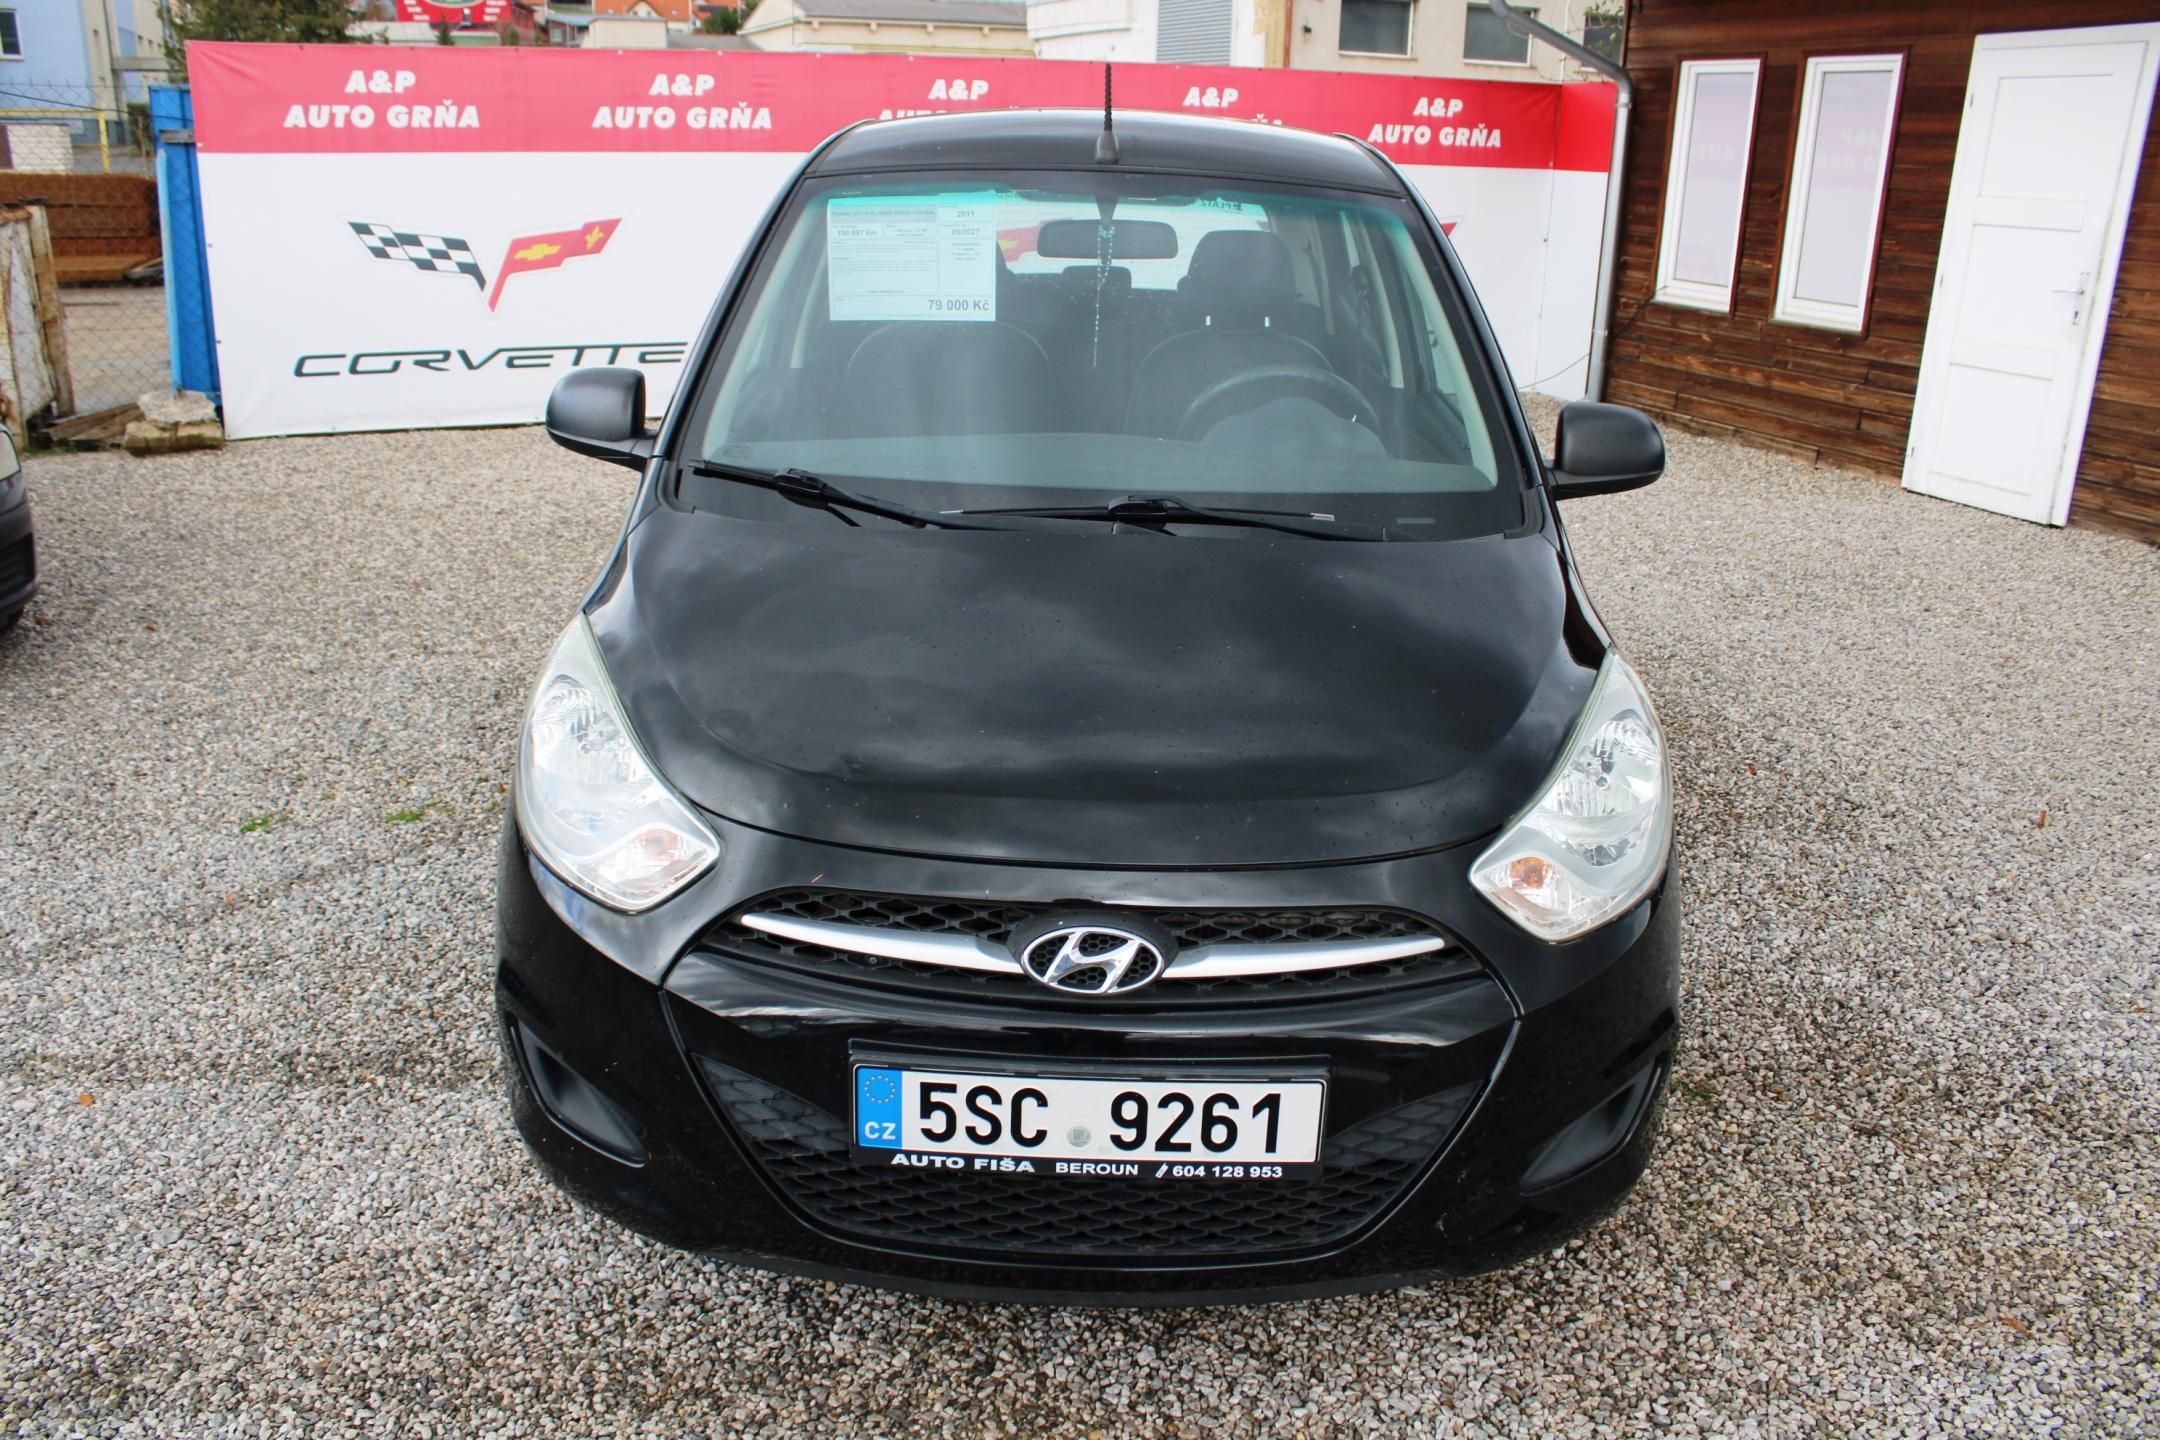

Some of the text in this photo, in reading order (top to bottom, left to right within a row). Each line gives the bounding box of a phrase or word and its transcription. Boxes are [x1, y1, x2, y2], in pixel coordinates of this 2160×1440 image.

[344, 69, 416, 94] A&P
[648, 73, 716, 97] A&P
[927, 78, 990, 101] A&P
[1182, 86, 1240, 109] A&P
[1412, 96, 1464, 118] A&P
[282, 98, 481, 129] AUTO GRŇA
[591, 100, 773, 130] AUTO GRŇA
[1366, 122, 1502, 148] AUTO GRŇA
[955, 209, 975, 218] 2011
[927, 298, 990, 311] 79 000 Kč
[293, 341, 689, 378] CORVETTE
[919, 1081, 1282, 1154] 5SC 9261
[863, 1120, 897, 1141] CZ
[890, 1152, 1283, 1179] AUTO FIŠA BEROUN 604 128 953
